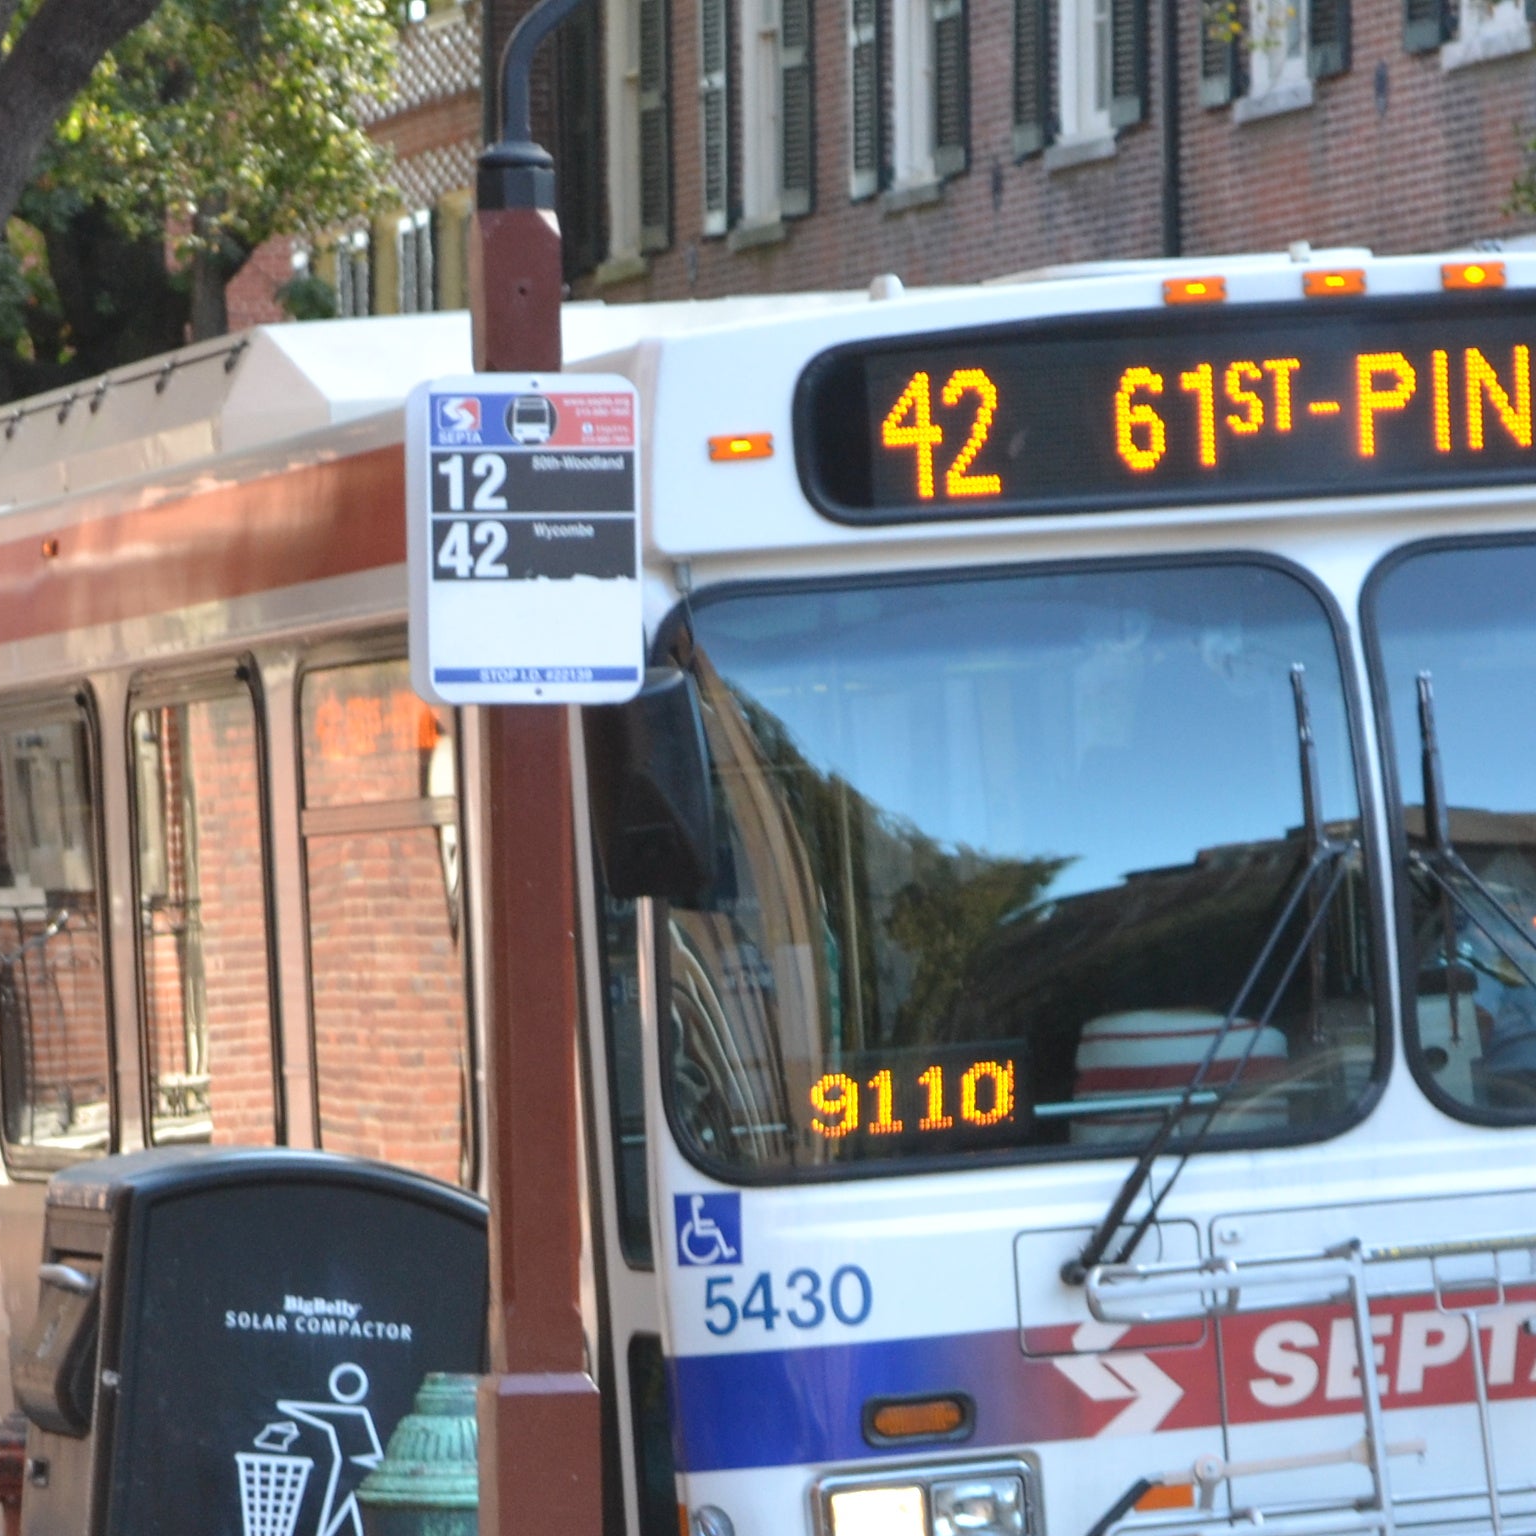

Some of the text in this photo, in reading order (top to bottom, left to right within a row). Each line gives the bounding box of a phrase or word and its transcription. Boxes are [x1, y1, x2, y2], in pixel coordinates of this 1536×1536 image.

[438, 432, 483, 445] SEPTA
[880, 366, 1003, 500] 42
[438, 453, 508, 512] 12
[437, 520, 510, 578] 42
[810, 1059, 1015, 1138] 9110
[225, 1310, 413, 1342] SOLAR COMPACTOR
[283, 1294, 358, 1319] BigBelly
[704, 1264, 873, 1336] 5430
